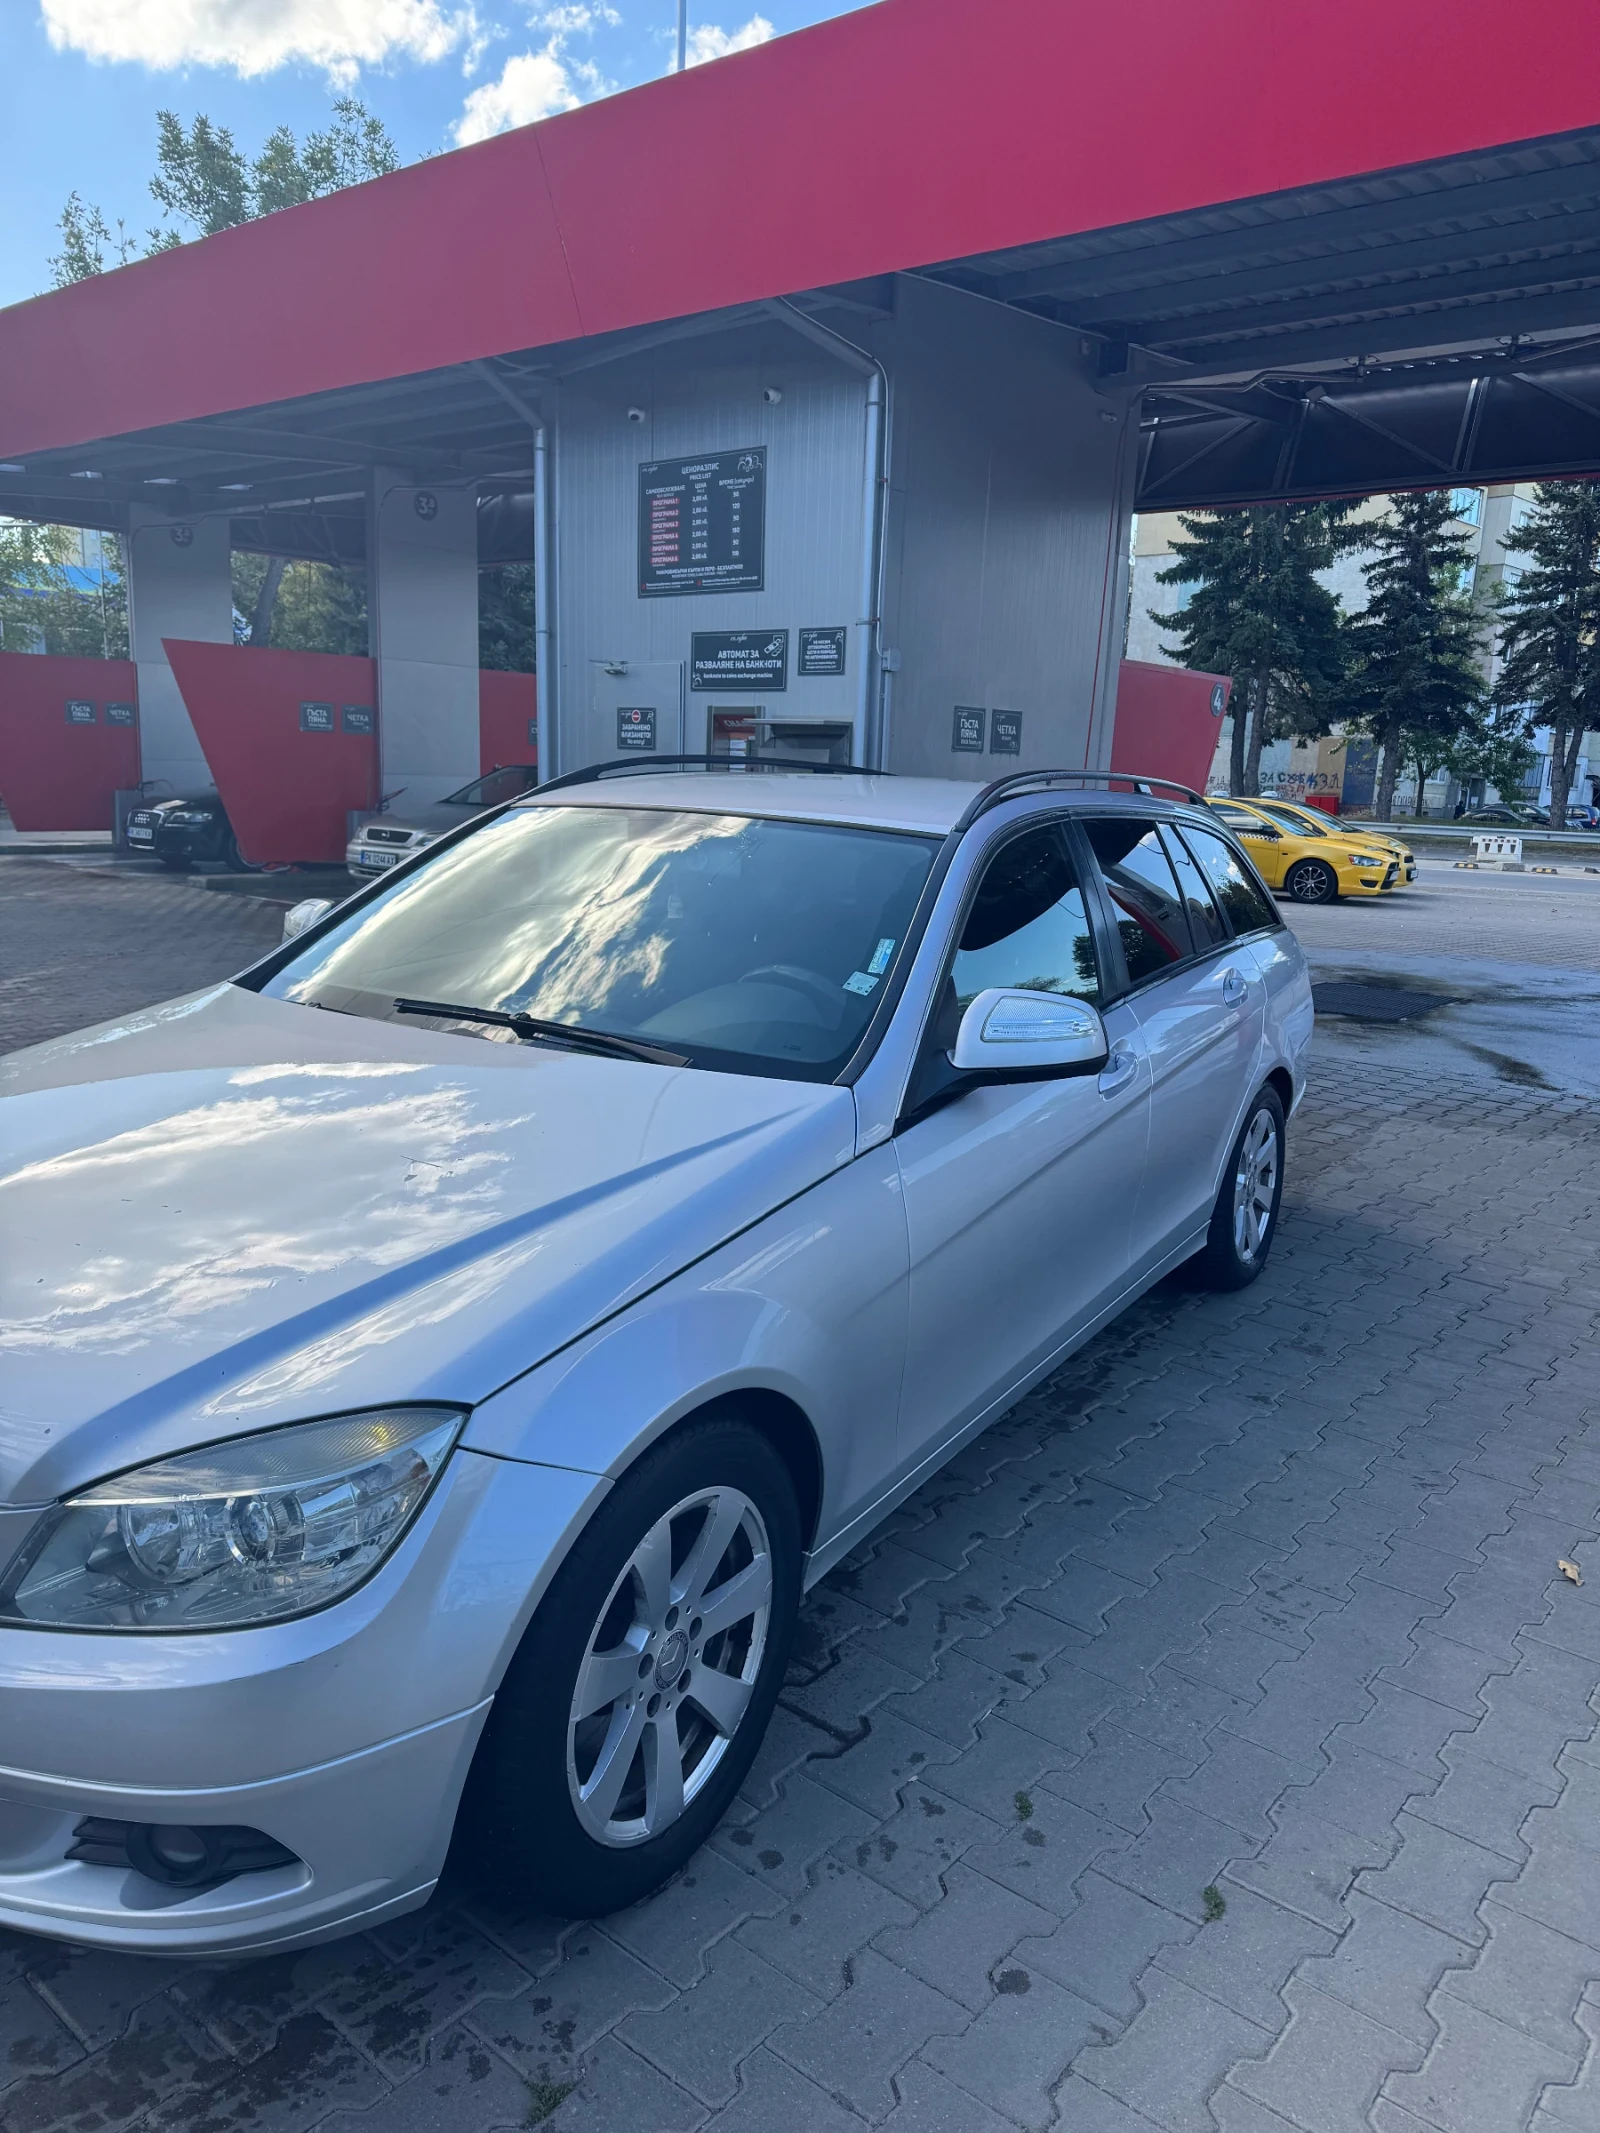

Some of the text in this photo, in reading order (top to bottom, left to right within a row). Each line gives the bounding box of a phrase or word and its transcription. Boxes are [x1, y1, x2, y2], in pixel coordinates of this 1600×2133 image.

[681, 462, 720, 474] ЦЕНОРАЗПИС
[646, 484, 686, 495] САМООБСЛУЖВАНЕ
[718, 650, 759, 658] АВТОМАТ ЗА
[696, 660, 782, 669] РАЗВАЛЯНЕ НА БАНКНОТИ
[1214, 689, 1221, 710] 4
[307, 709, 327, 717] ГЪСТА
[960, 719, 978, 729] ГЪСТА
[960, 729, 977, 739] ПЯНА
[997, 725, 1016, 735] ЧЕТКА
[364, 853, 372, 862] PK
[373, 854, 386, 864] 0244
